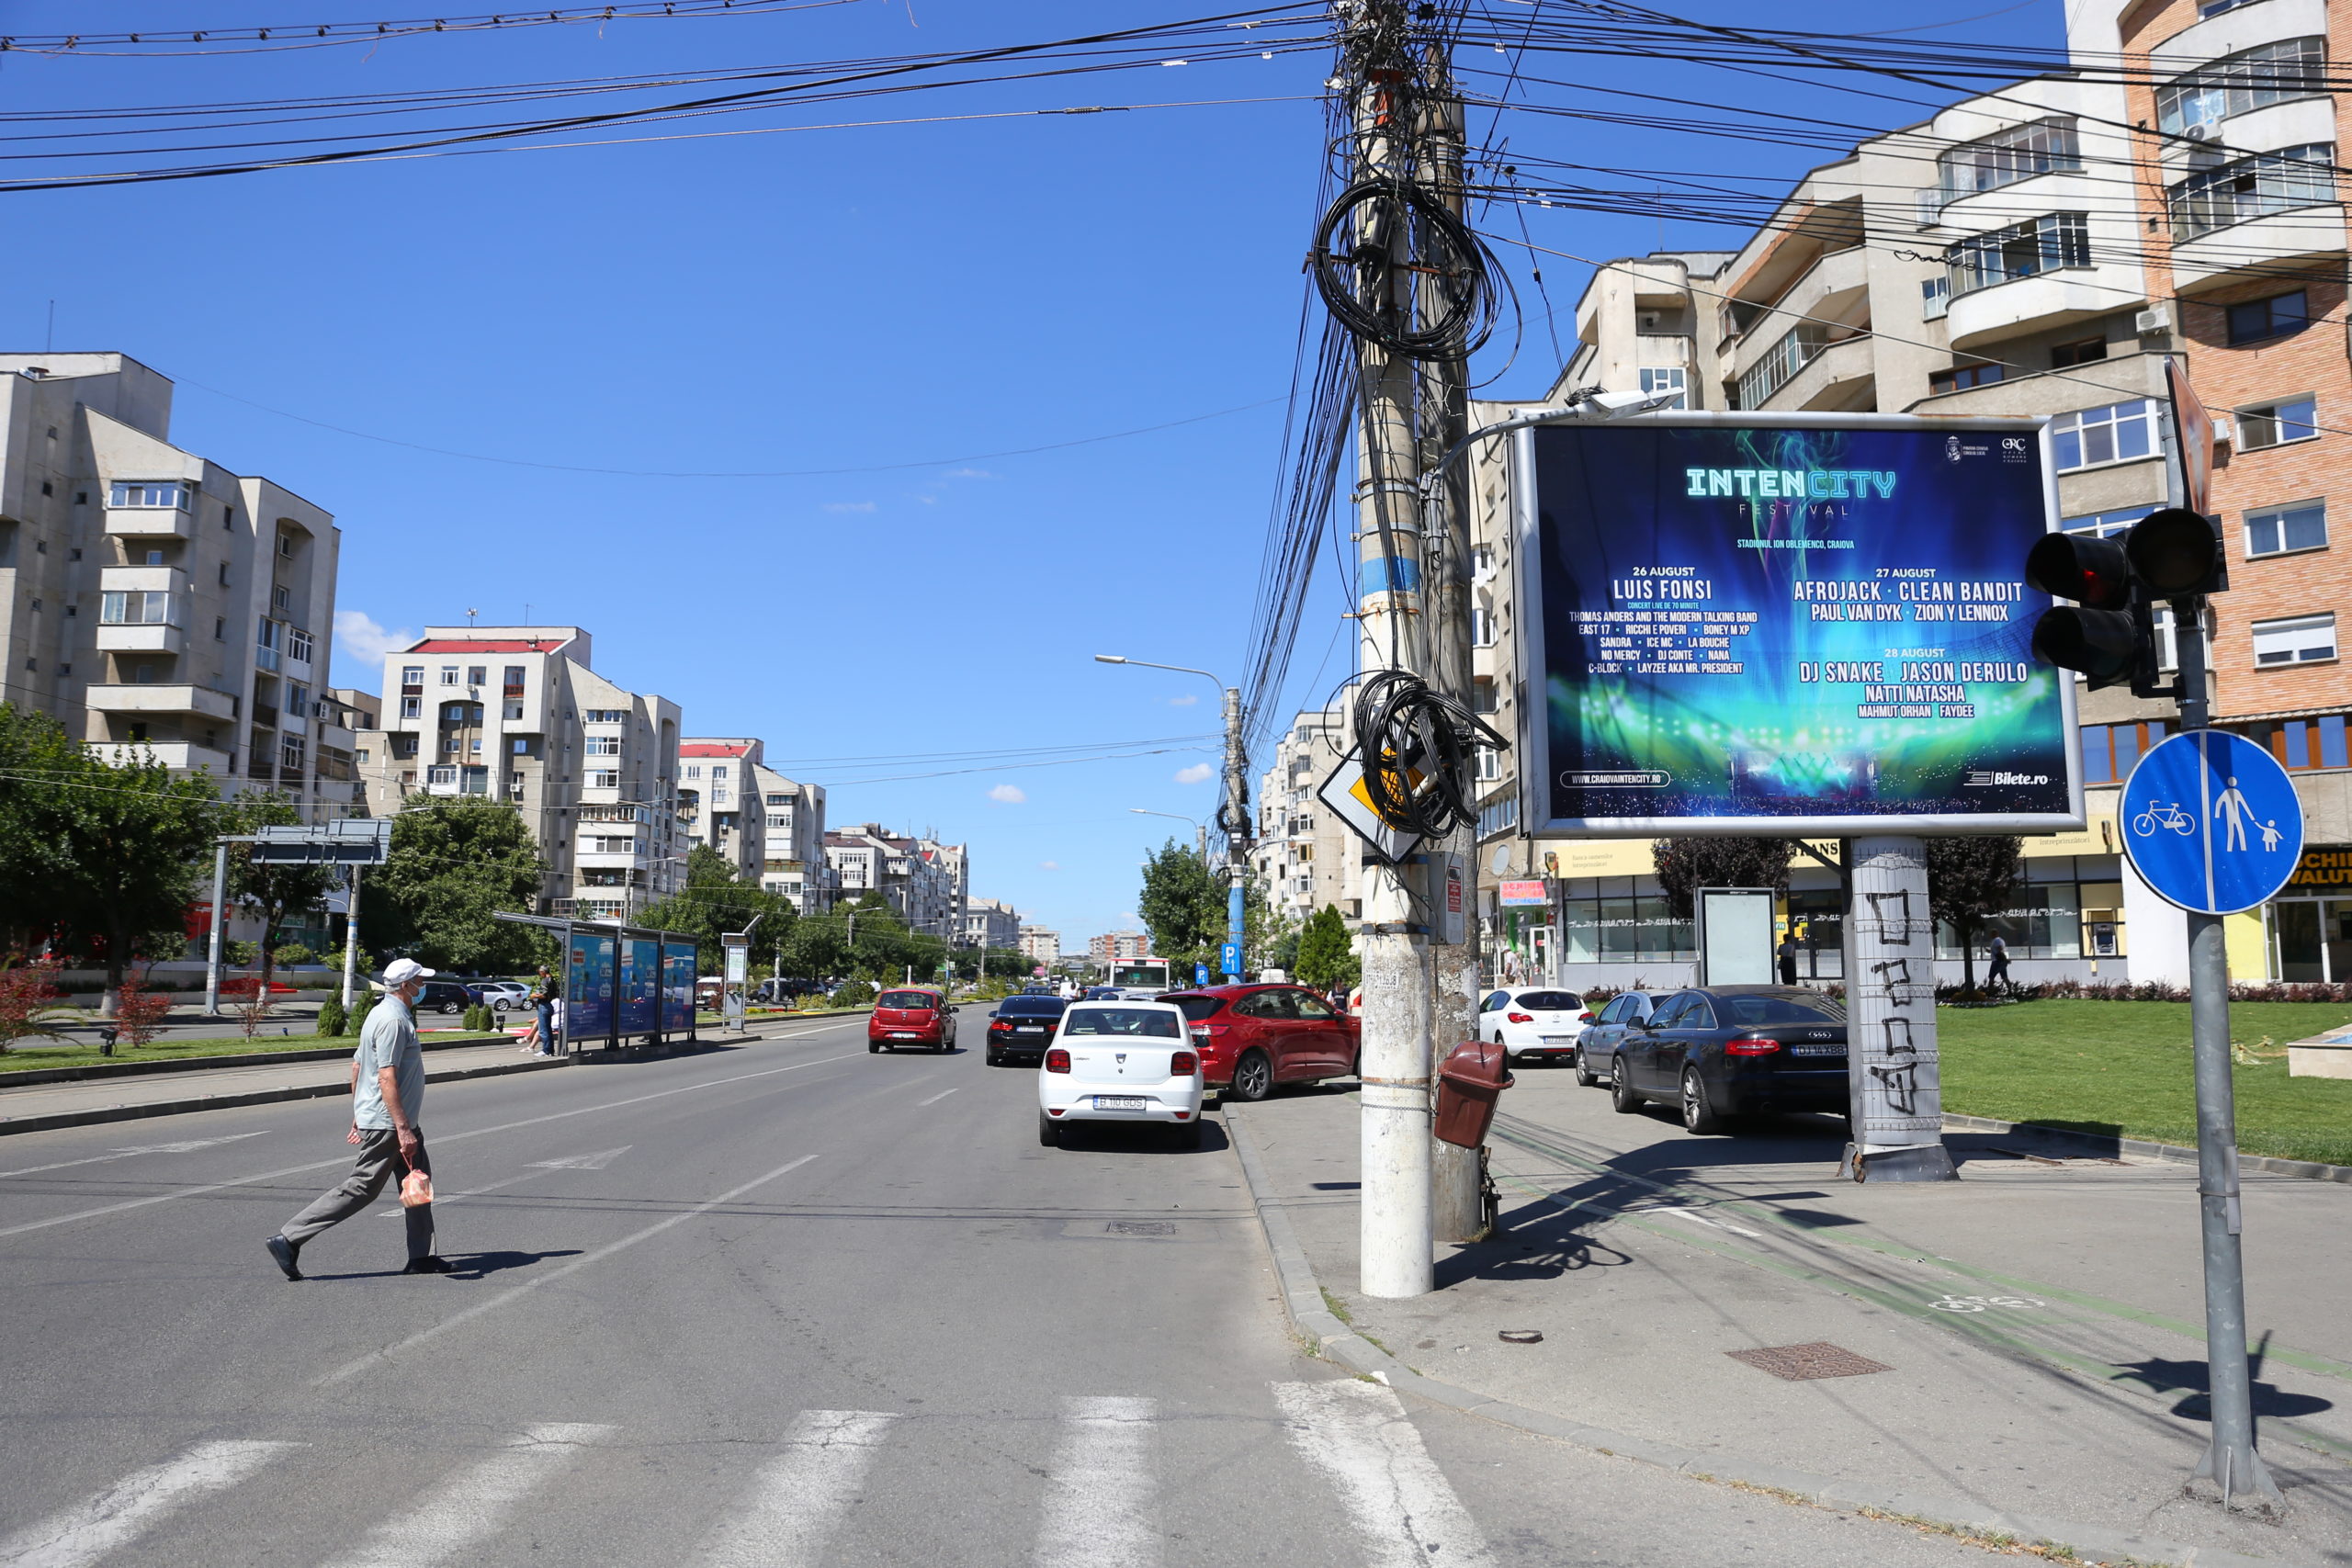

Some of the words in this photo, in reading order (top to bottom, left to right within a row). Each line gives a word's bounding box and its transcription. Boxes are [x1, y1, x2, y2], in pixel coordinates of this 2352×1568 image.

[1686, 468, 1896, 498] INTENCITY
[1739, 504, 1849, 516] FESTIVAL
[1737, 539, 1772, 549] STADIONUL
[1773, 539, 1785, 549] ION
[1785, 539, 1826, 549] OBLEMENCO,
[1827, 539, 1854, 549] CRAIOVA
[1633, 567, 1647, 576] 26
[1649, 567, 1695, 576] AUGUST
[1876, 569, 1890, 578] 27
[1892, 569, 1936, 578] AUGUST
[1613, 580, 1653, 599] LUIS
[1660, 580, 1712, 599] FONSI
[1793, 581, 1882, 601] AFROJACK
[1899, 581, 1953, 601] CLEAN
[1960, 581, 2022, 601] BANDIT
[1569, 612, 1602, 622] THOMAS
[1603, 612, 1634, 622] ANDERS
[1635, 612, 1652, 622] AND
[1653, 612, 1668, 622] THE
[1669, 612, 1702, 622] MODERN
[1703, 612, 1735, 622] TALKING
[1736, 612, 1758, 622] BAND
[1811, 604, 1844, 621] PAUL
[1847, 604, 1875, 621] VAN
[1876, 604, 1903, 621] DYK
[1914, 604, 1946, 621] ZION
[1947, 604, 1956, 621] Y
[1958, 604, 2008, 621] LENNOX
[1579, 625, 1598, 635] EAST
[1600, 625, 1610, 635] 17
[1625, 625, 1651, 635] RICCHI
[1653, 625, 1657, 635] E
[1659, 625, 1687, 635] POVERI
[1703, 625, 1729, 636] BONEY
[1731, 625, 1738, 636] M
[1739, 625, 1750, 636] XP
[1600, 637, 1632, 648] SANDRA
[1646, 637, 1659, 648] ICE
[1660, 637, 1673, 648] MC
[1688, 637, 1698, 648] LA
[1699, 637, 1729, 648] BOUCHE
[1601, 650, 1612, 660] NO
[1614, 650, 1640, 660] MERCY
[1657, 650, 1667, 660] DJ
[1668, 650, 1693, 660] CONTE
[1708, 650, 1730, 660] NANA
[1884, 649, 1899, 658] 28
[1902, 649, 1945, 658] AUGUST
[1589, 663, 1623, 673] C-BLOCK
[1637, 663, 1667, 673] LAYZEE
[1668, 663, 1684, 673] AKA
[1685, 663, 1700, 673] MR.
[1702, 663, 1743, 673] PRESIDENT
[1800, 662, 1819, 682] DJ
[1826, 662, 1883, 682] SNAKE
[1901, 662, 1954, 682] JASON
[1962, 662, 2028, 682] DERULO
[1865, 685, 1904, 703] NATTI
[1905, 685, 1966, 703] NATASHA
[1858, 705, 1899, 717] MAHMUT
[1900, 705, 1931, 717] ORHAN
[1939, 705, 1974, 717] FAYDEE
[1571, 774, 1661, 784] WWW.CRAIOVAINTENCITY.RO
[1995, 772, 2048, 784] Bilete.ro
[1226, 946, 1236, 964] P
[1799, 1046, 1811, 1055] DJ
[1815, 1046, 1823, 1055] 14
[1825, 1045, 1844, 1055] XBB
[1100, 1098, 1106, 1106] B
[1110, 1098, 1121, 1106] 110
[1124, 1099, 1142, 1107] GDS
